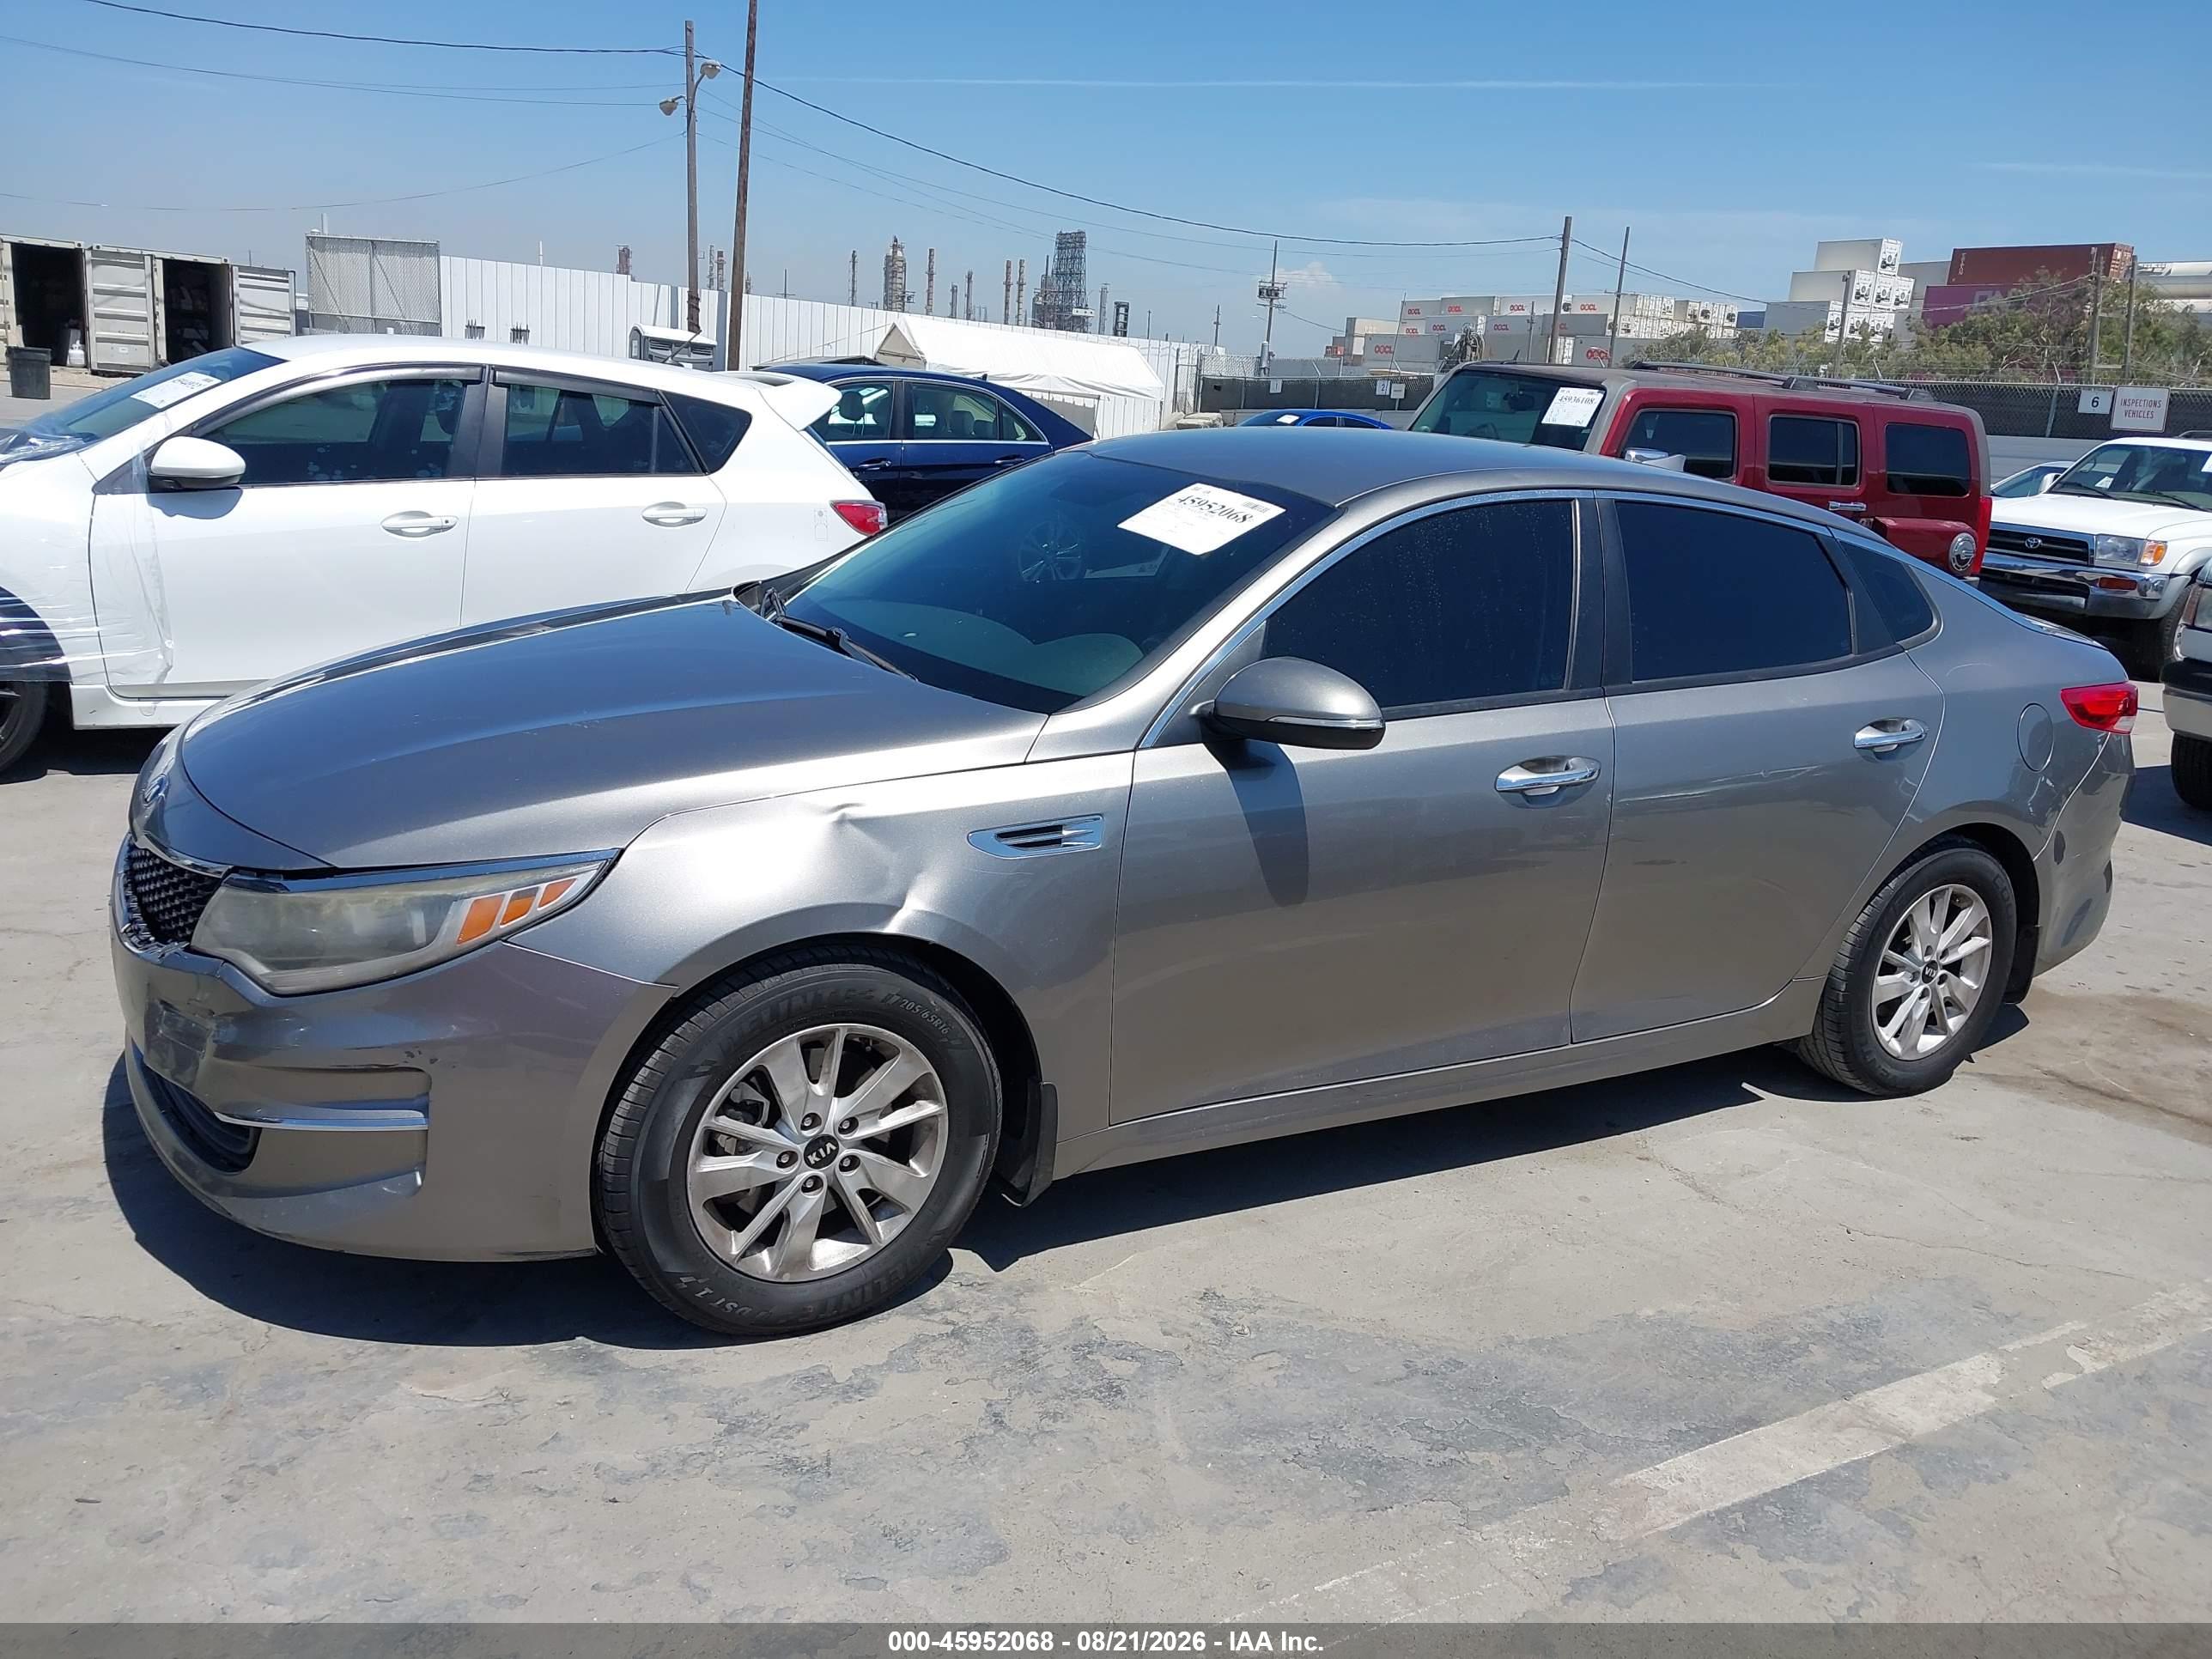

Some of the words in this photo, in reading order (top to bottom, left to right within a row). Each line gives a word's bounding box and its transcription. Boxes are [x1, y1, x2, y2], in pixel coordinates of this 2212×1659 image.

[1374, 344, 1394, 354] OOCL
[2091, 396, 2100, 408] 6
[2120, 398, 2162, 409] INSPECTIONS
[2124, 410, 2154, 419] VEHICLES
[1177, 495, 1254, 523] 45952068
[899, 999, 951, 1034] 205/65R16
[807, 1142, 837, 1165] KIA
